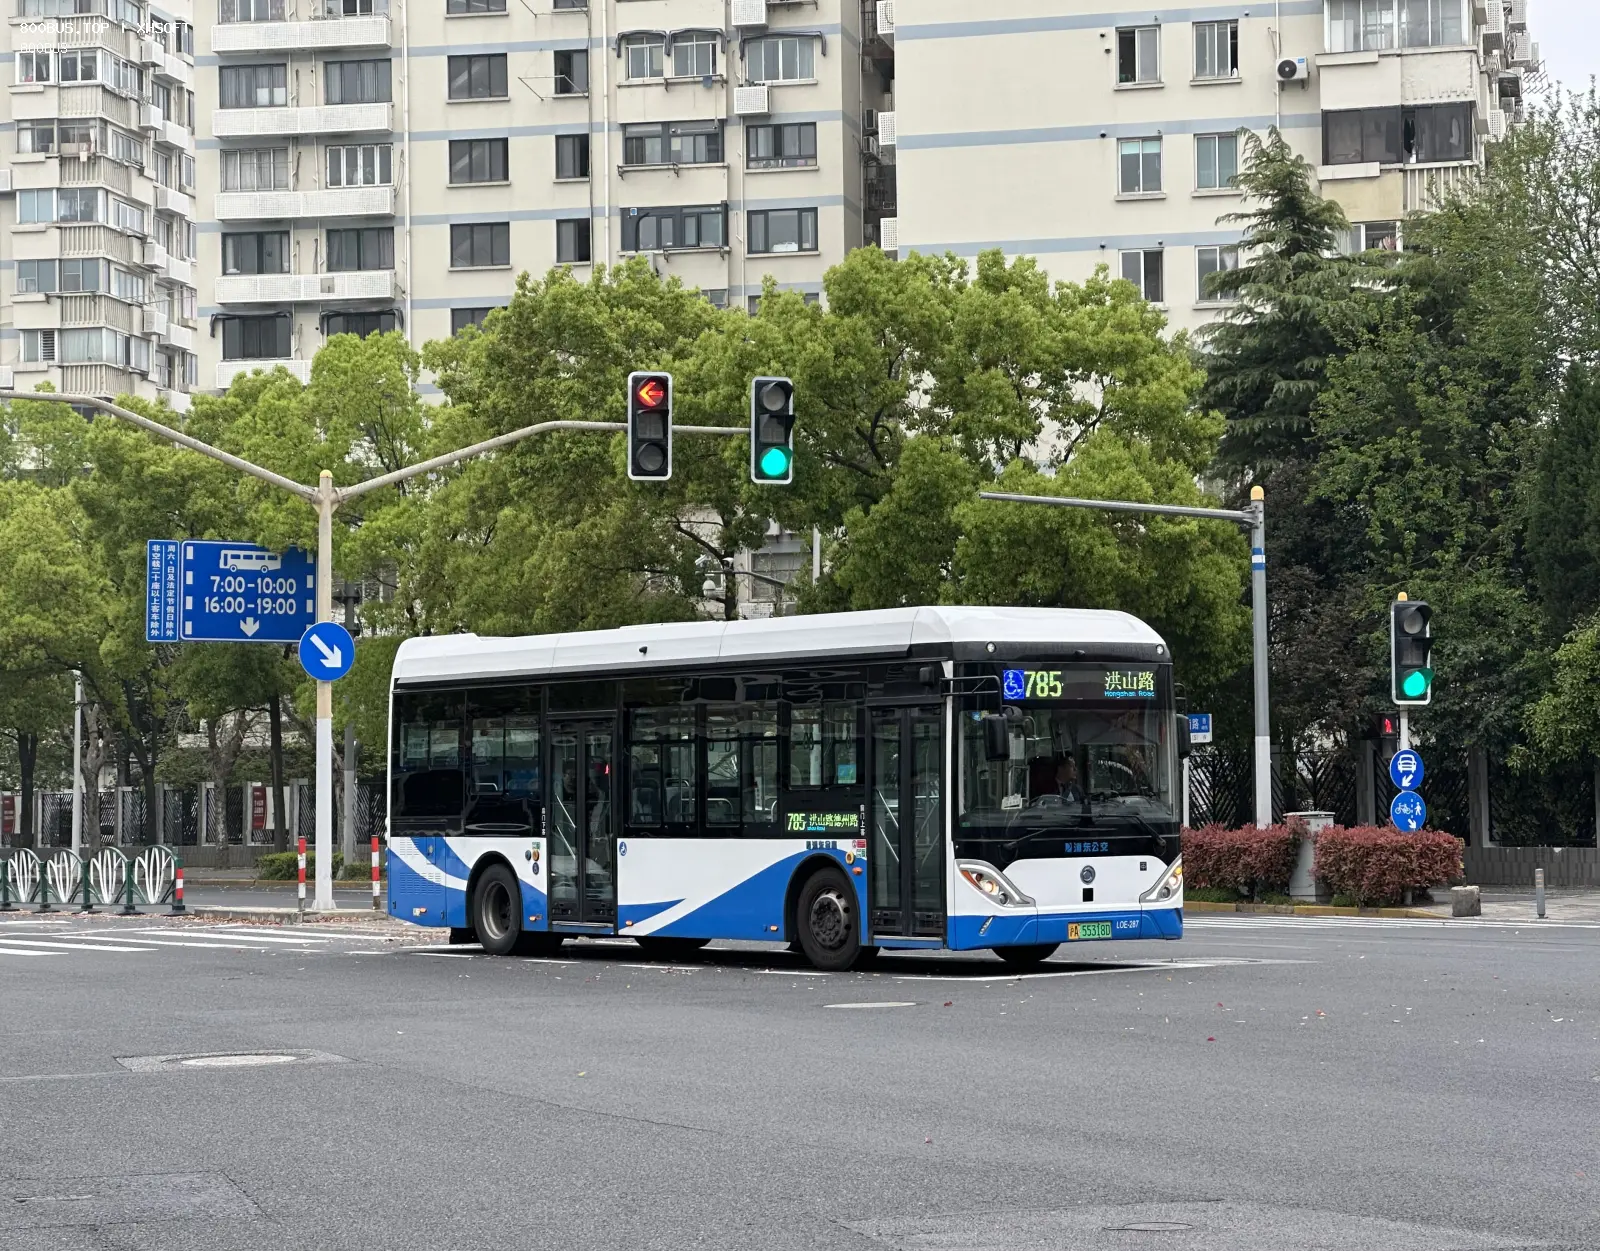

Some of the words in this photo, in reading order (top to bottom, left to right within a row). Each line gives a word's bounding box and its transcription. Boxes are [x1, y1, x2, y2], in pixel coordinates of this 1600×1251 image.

[1024, 670, 1063, 698] 785
[1104, 671, 1155, 691] 洪山路
[809, 813, 858, 827] 洪山路德州路
